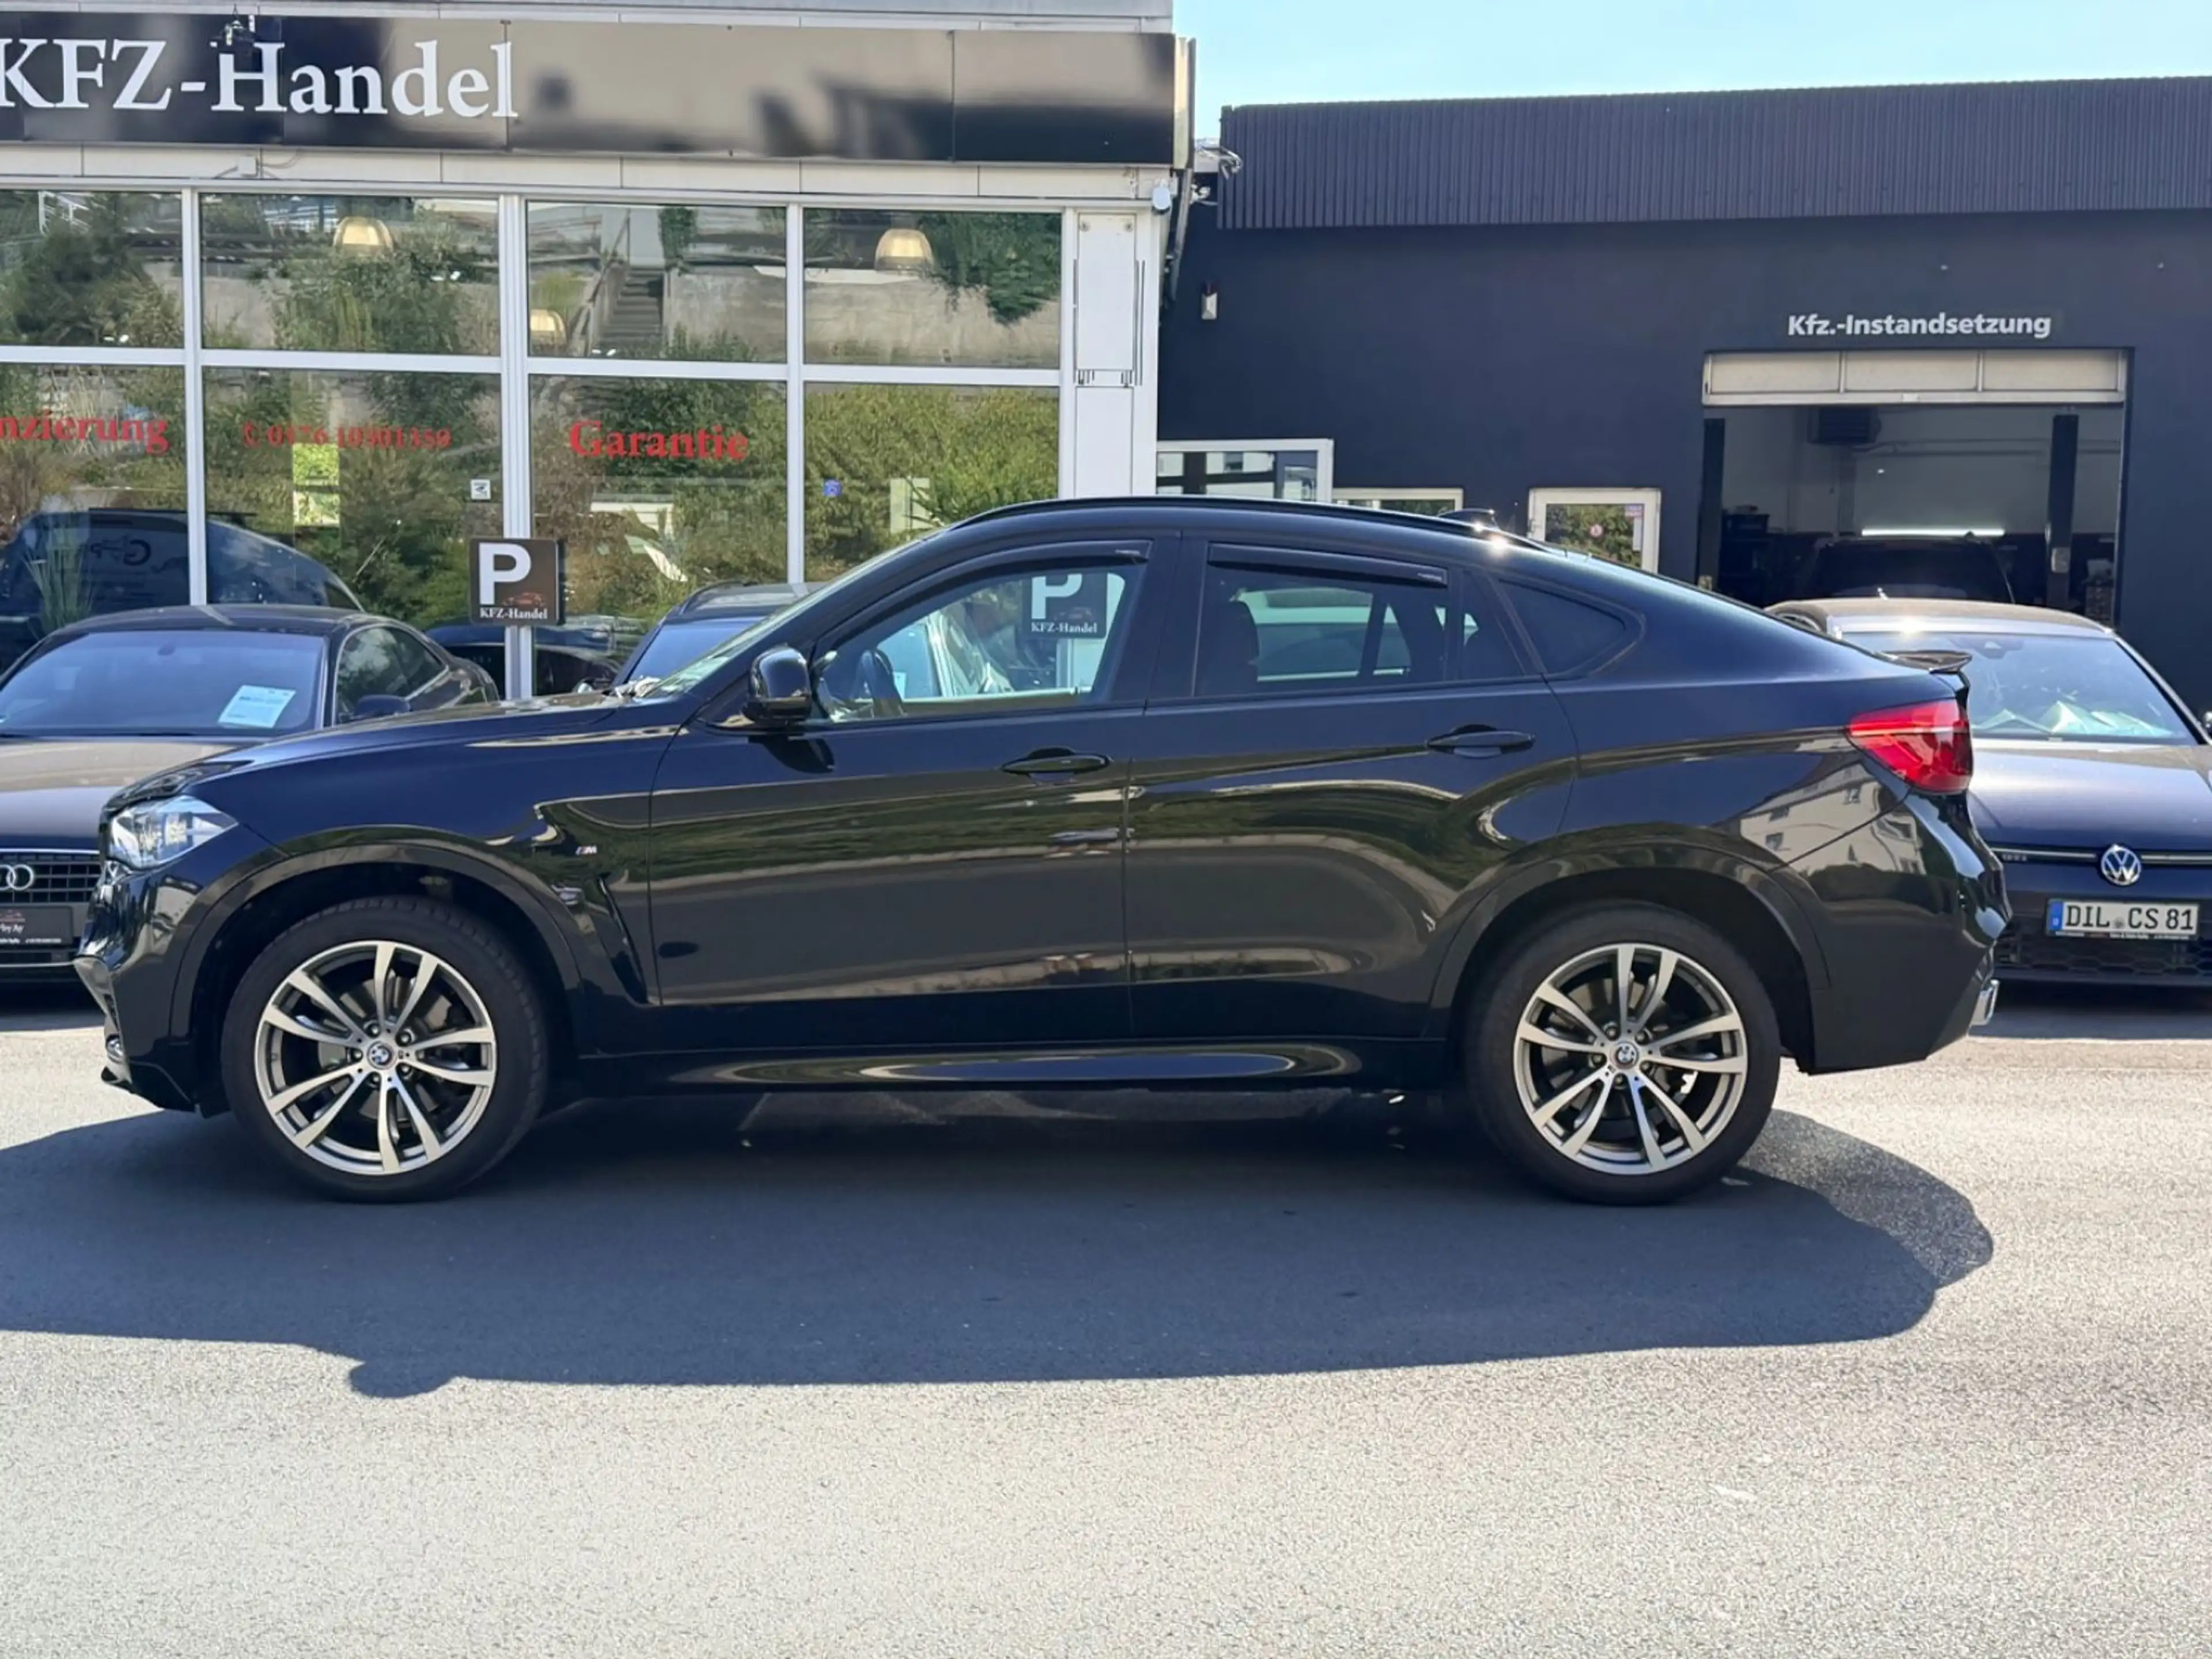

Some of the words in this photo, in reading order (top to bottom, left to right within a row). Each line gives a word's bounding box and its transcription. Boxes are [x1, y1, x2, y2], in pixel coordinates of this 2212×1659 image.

[0, 39, 518, 118] KFZ-Handel
[1788, 313, 2051, 339] Kfz.-Instandsetzung
[569, 420, 748, 460] Garantie
[479, 542, 531, 605] P
[479, 607, 548, 619] KFZ-Handel
[1031, 621, 1097, 633] KFZ-Handel
[2066, 905, 2110, 927] DIL
[2128, 908, 2159, 929] CS
[2165, 908, 2193, 930] 81
